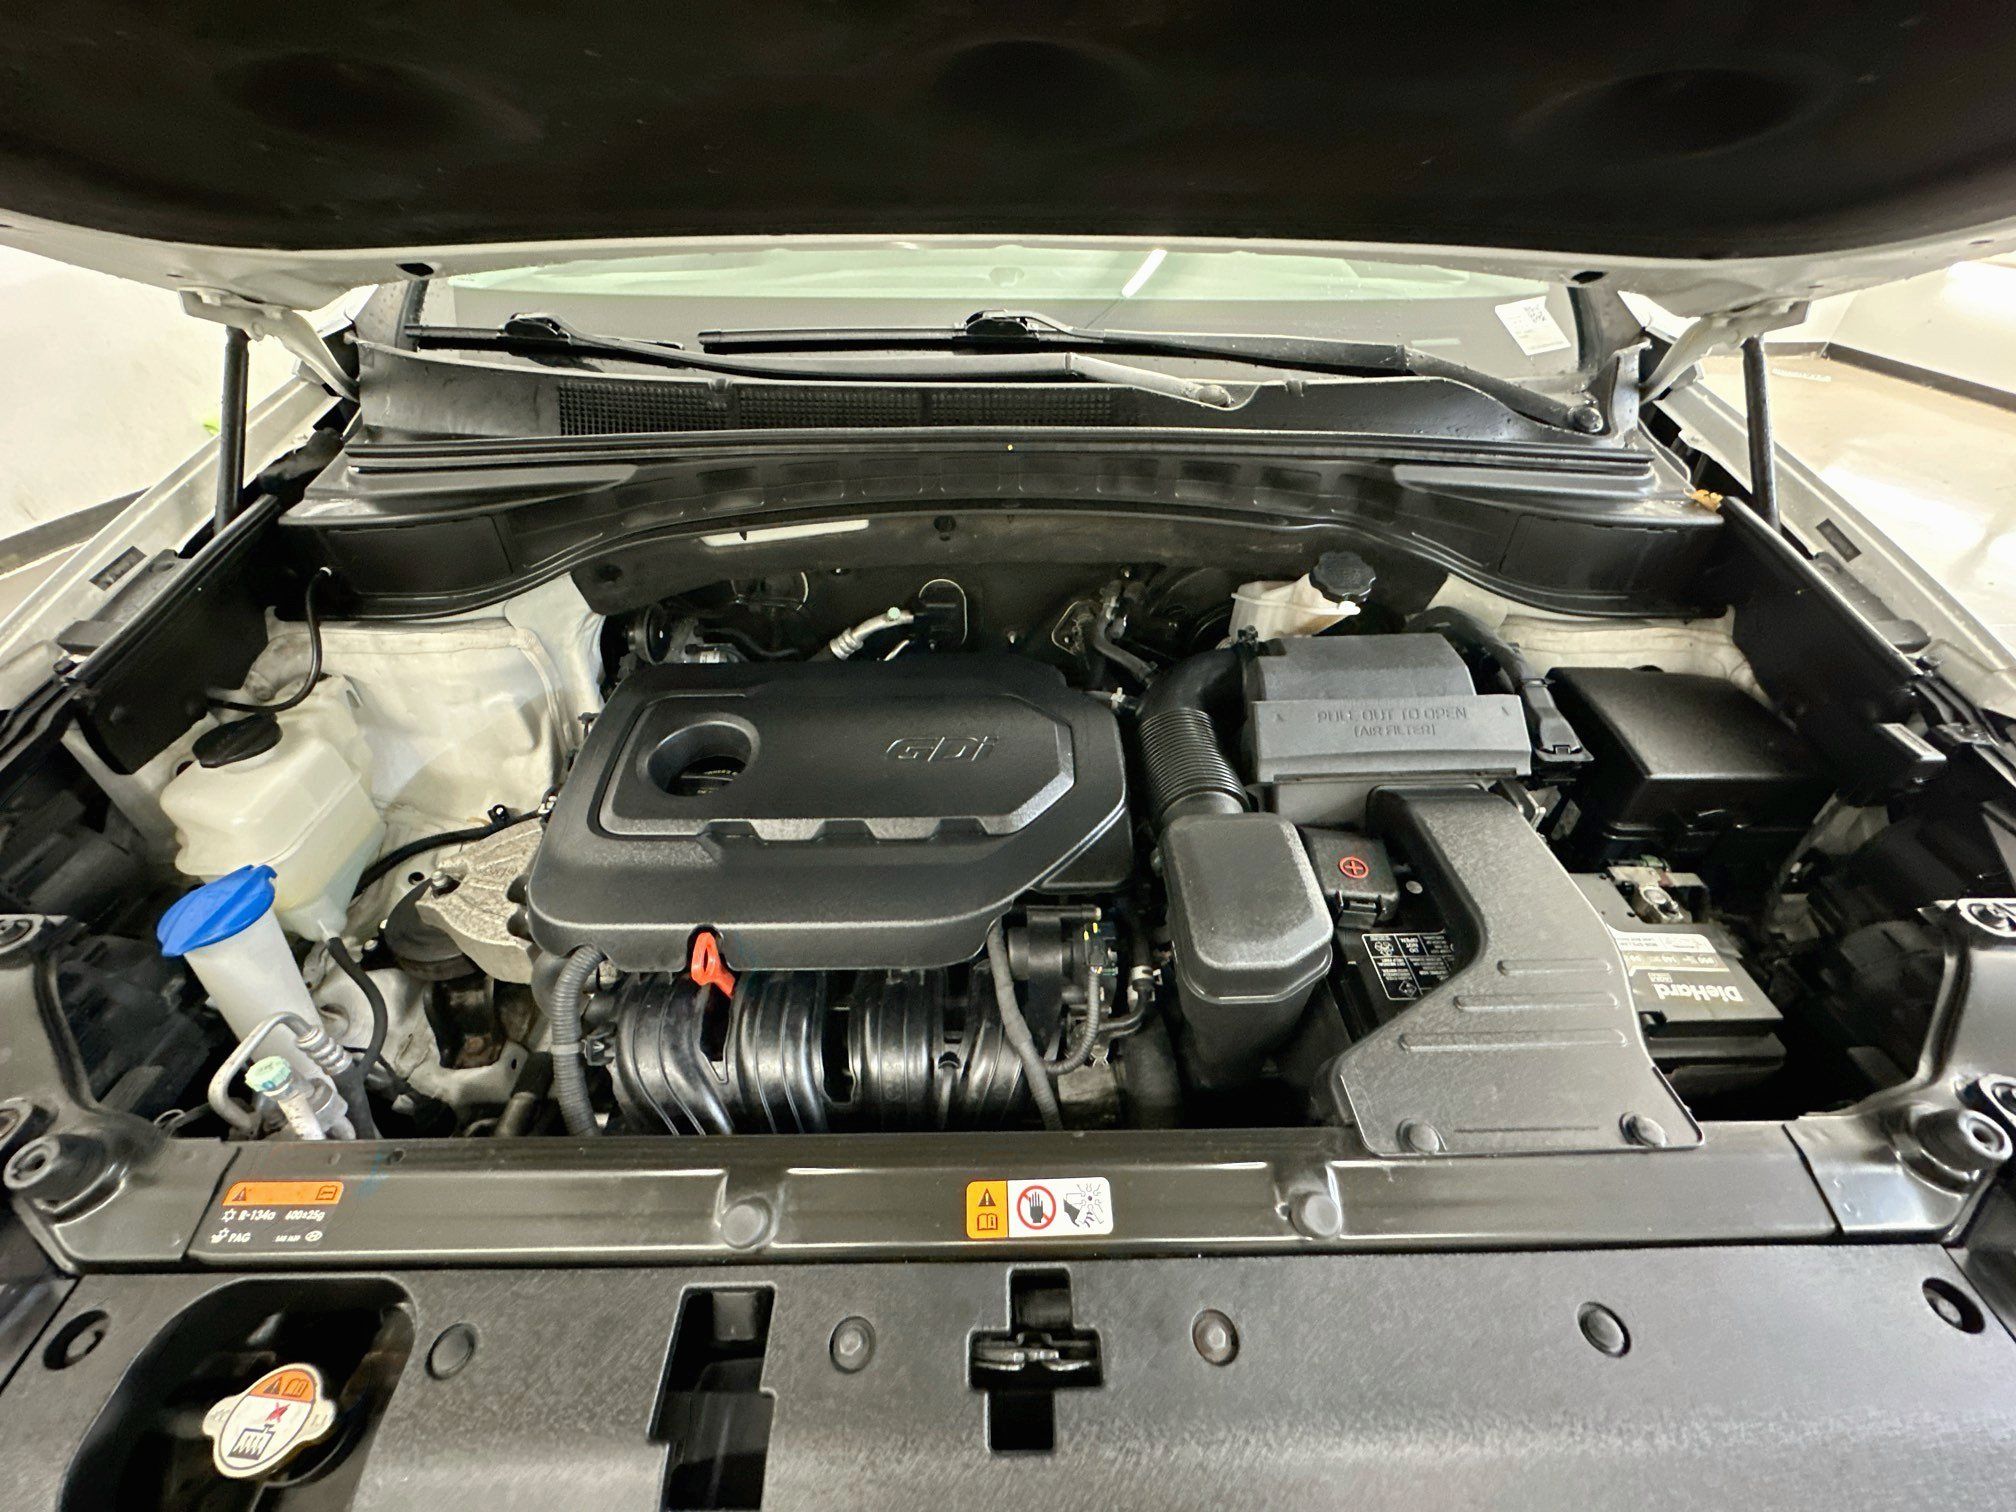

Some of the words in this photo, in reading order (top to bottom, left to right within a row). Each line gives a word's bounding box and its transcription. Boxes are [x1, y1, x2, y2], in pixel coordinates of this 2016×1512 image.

[1316, 709, 1354, 723] PULL
[1362, 708, 1394, 721] OUT
[1402, 707, 1420, 720] TO
[1424, 706, 1468, 720] OPEN
[1653, 983, 1744, 1002] DieHard
[227, 1232, 251, 1243] PAG
